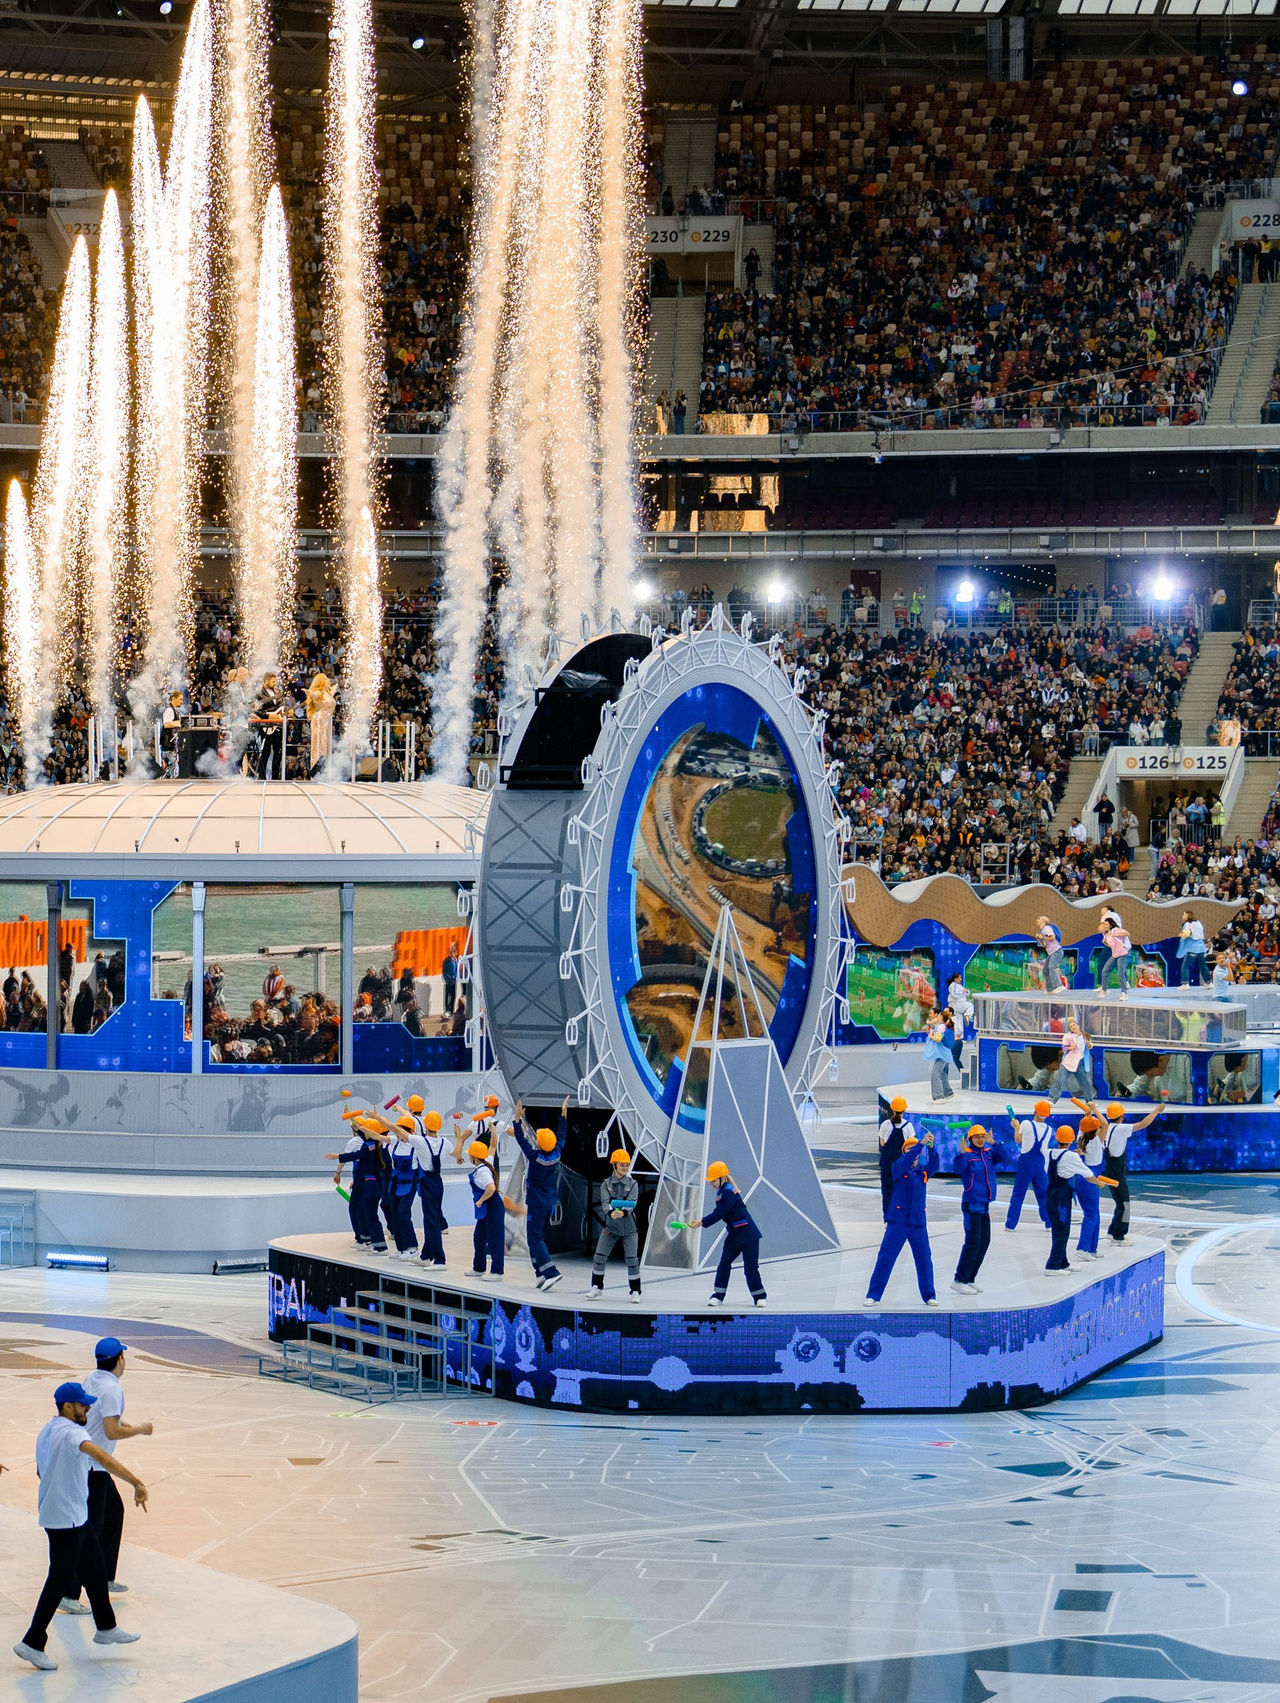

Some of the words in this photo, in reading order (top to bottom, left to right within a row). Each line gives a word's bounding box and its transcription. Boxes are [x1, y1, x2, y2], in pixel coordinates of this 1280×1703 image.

[1252, 214, 1280, 227] 228
[73, 223, 101, 236] 232
[702, 230, 731, 242] 229
[650, 231, 679, 243] 230
[1139, 756, 1169, 769] 126
[1196, 756, 1227, 769] 125
